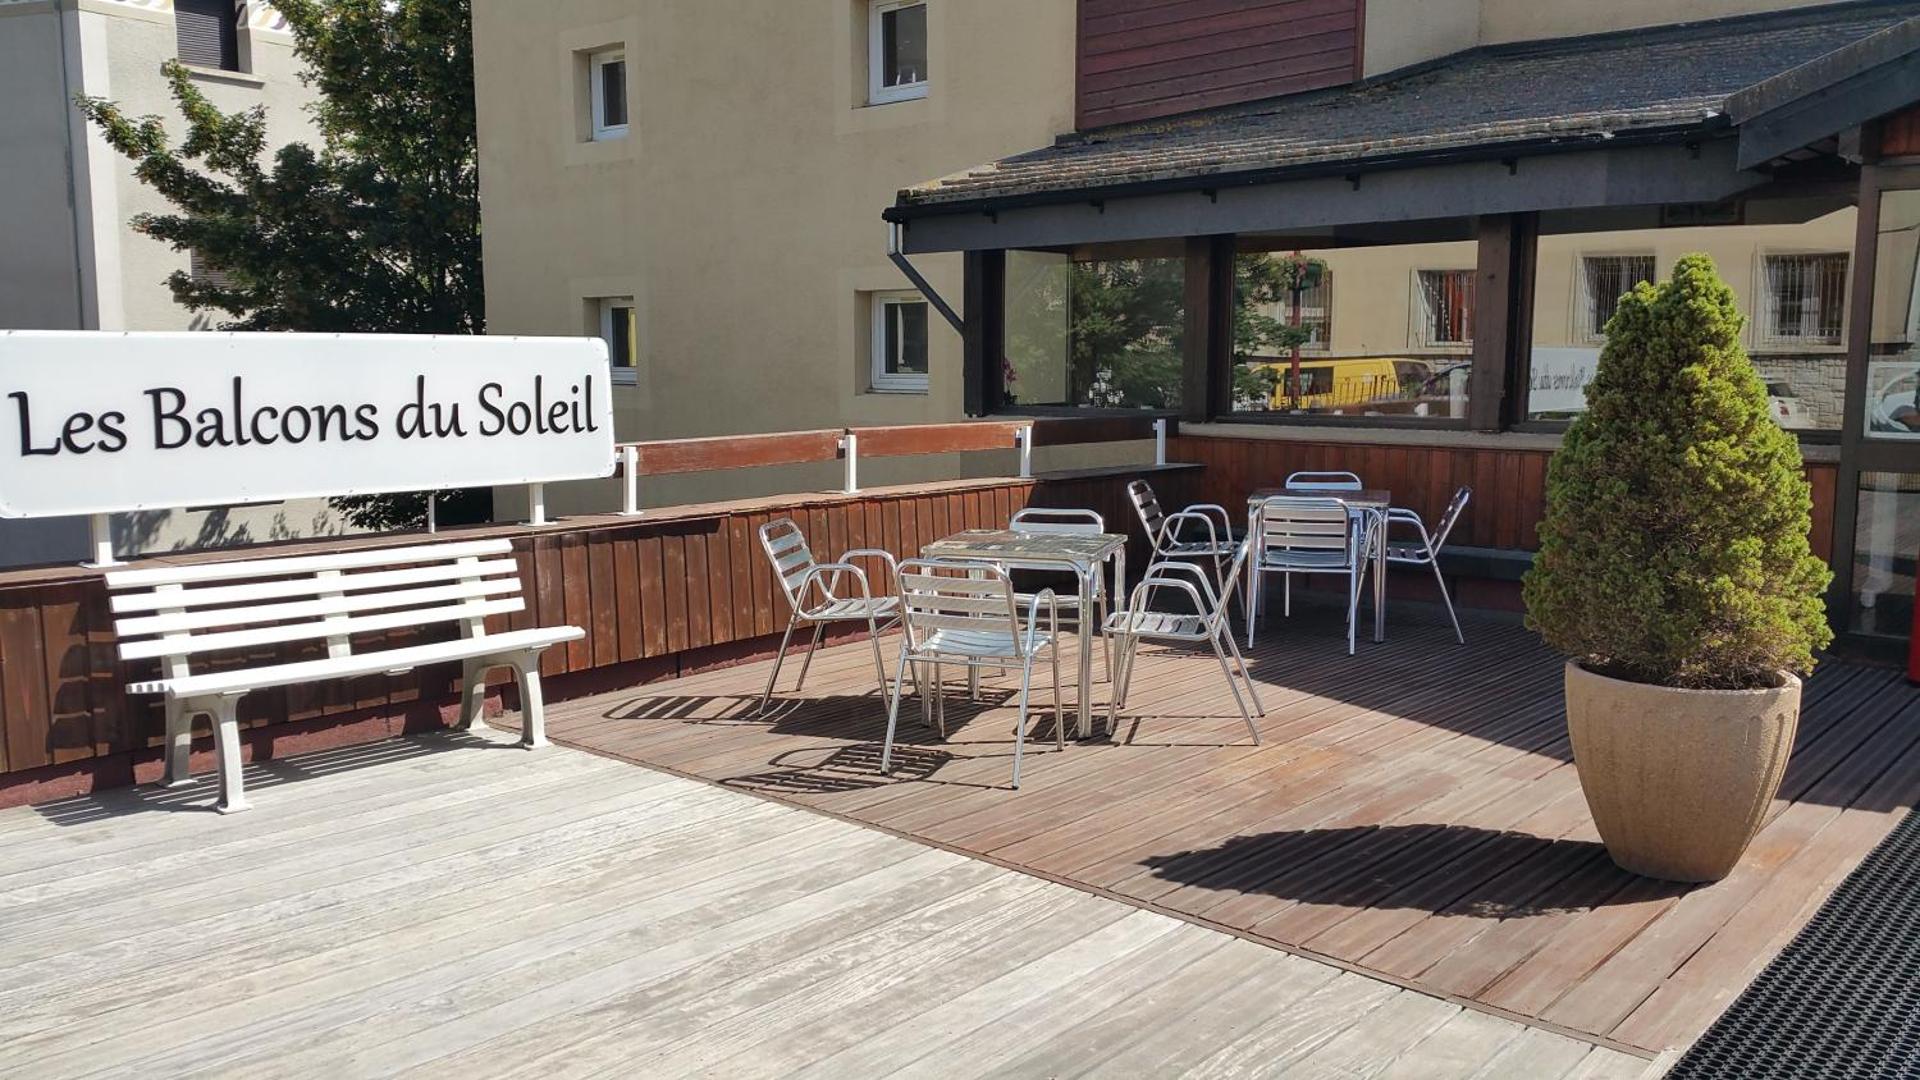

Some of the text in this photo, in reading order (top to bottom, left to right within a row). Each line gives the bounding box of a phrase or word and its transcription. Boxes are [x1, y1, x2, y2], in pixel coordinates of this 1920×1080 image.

[8, 374, 599, 457] Les Balcons du Soleil
